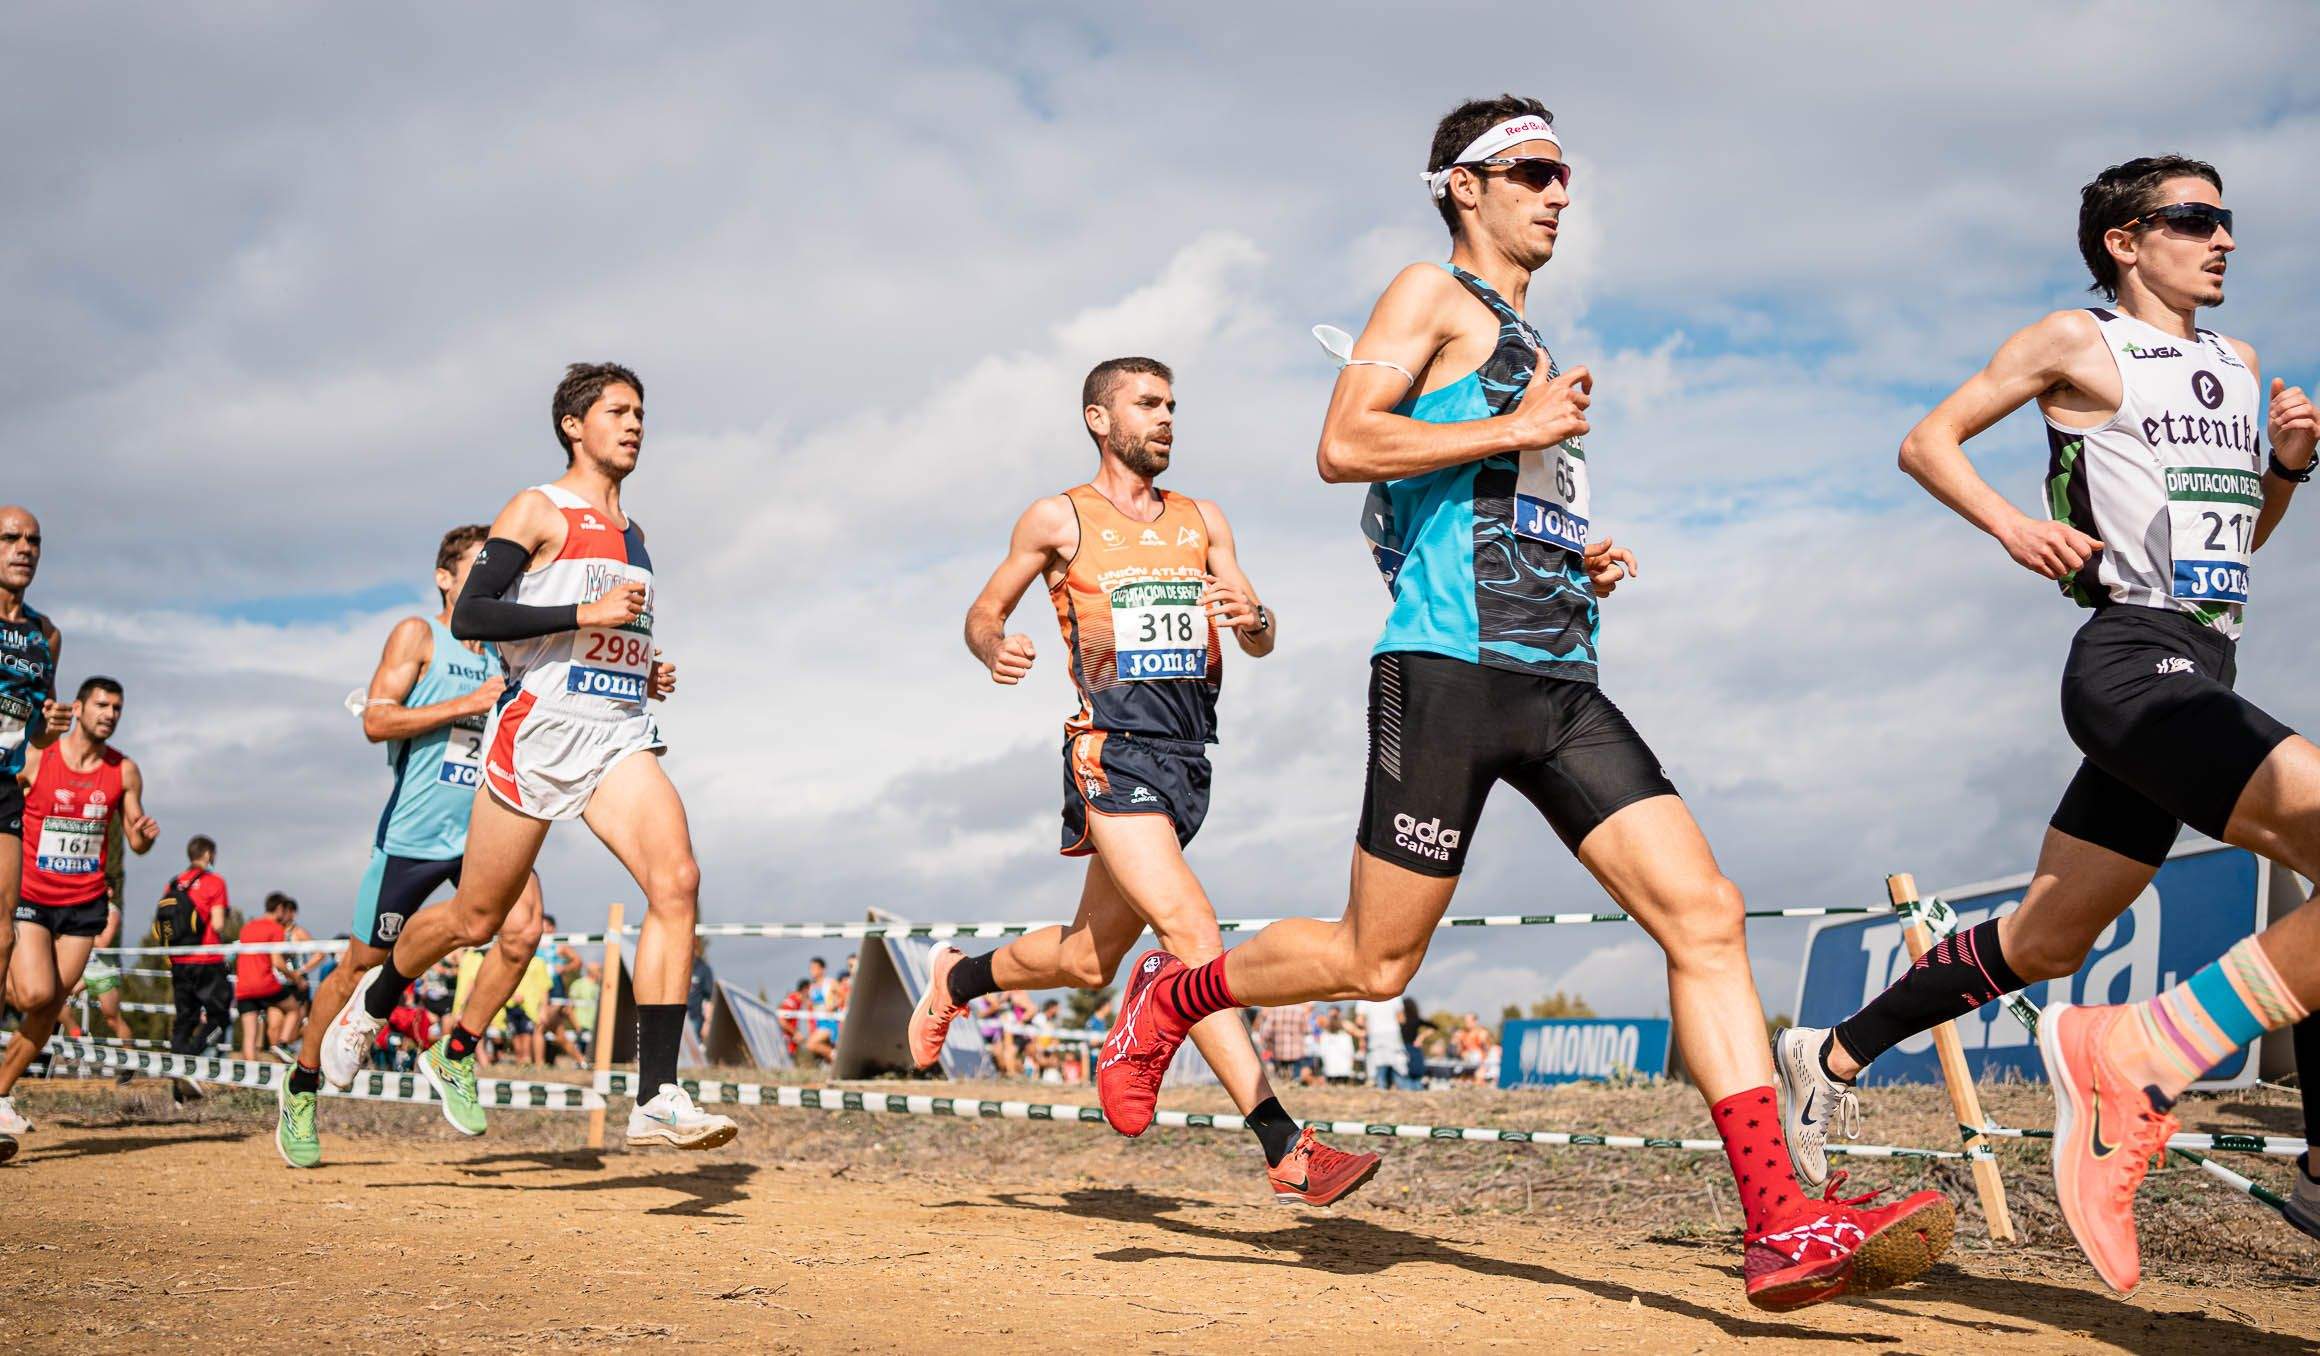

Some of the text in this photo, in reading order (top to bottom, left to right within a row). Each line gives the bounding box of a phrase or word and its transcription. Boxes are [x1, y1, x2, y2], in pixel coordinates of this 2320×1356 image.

[1505, 122, 1529, 136] Red
[1556, 456, 1576, 504] 65
[2166, 473, 2239, 494] DIPUTACION
[1139, 612, 1193, 642] 318
[585, 632, 650, 669] 2984
[1393, 812, 1461, 849] ada
[58, 838, 90, 854] 161
[1395, 833, 1450, 861] Calvià
[1537, 1024, 1640, 1077] MONDO
